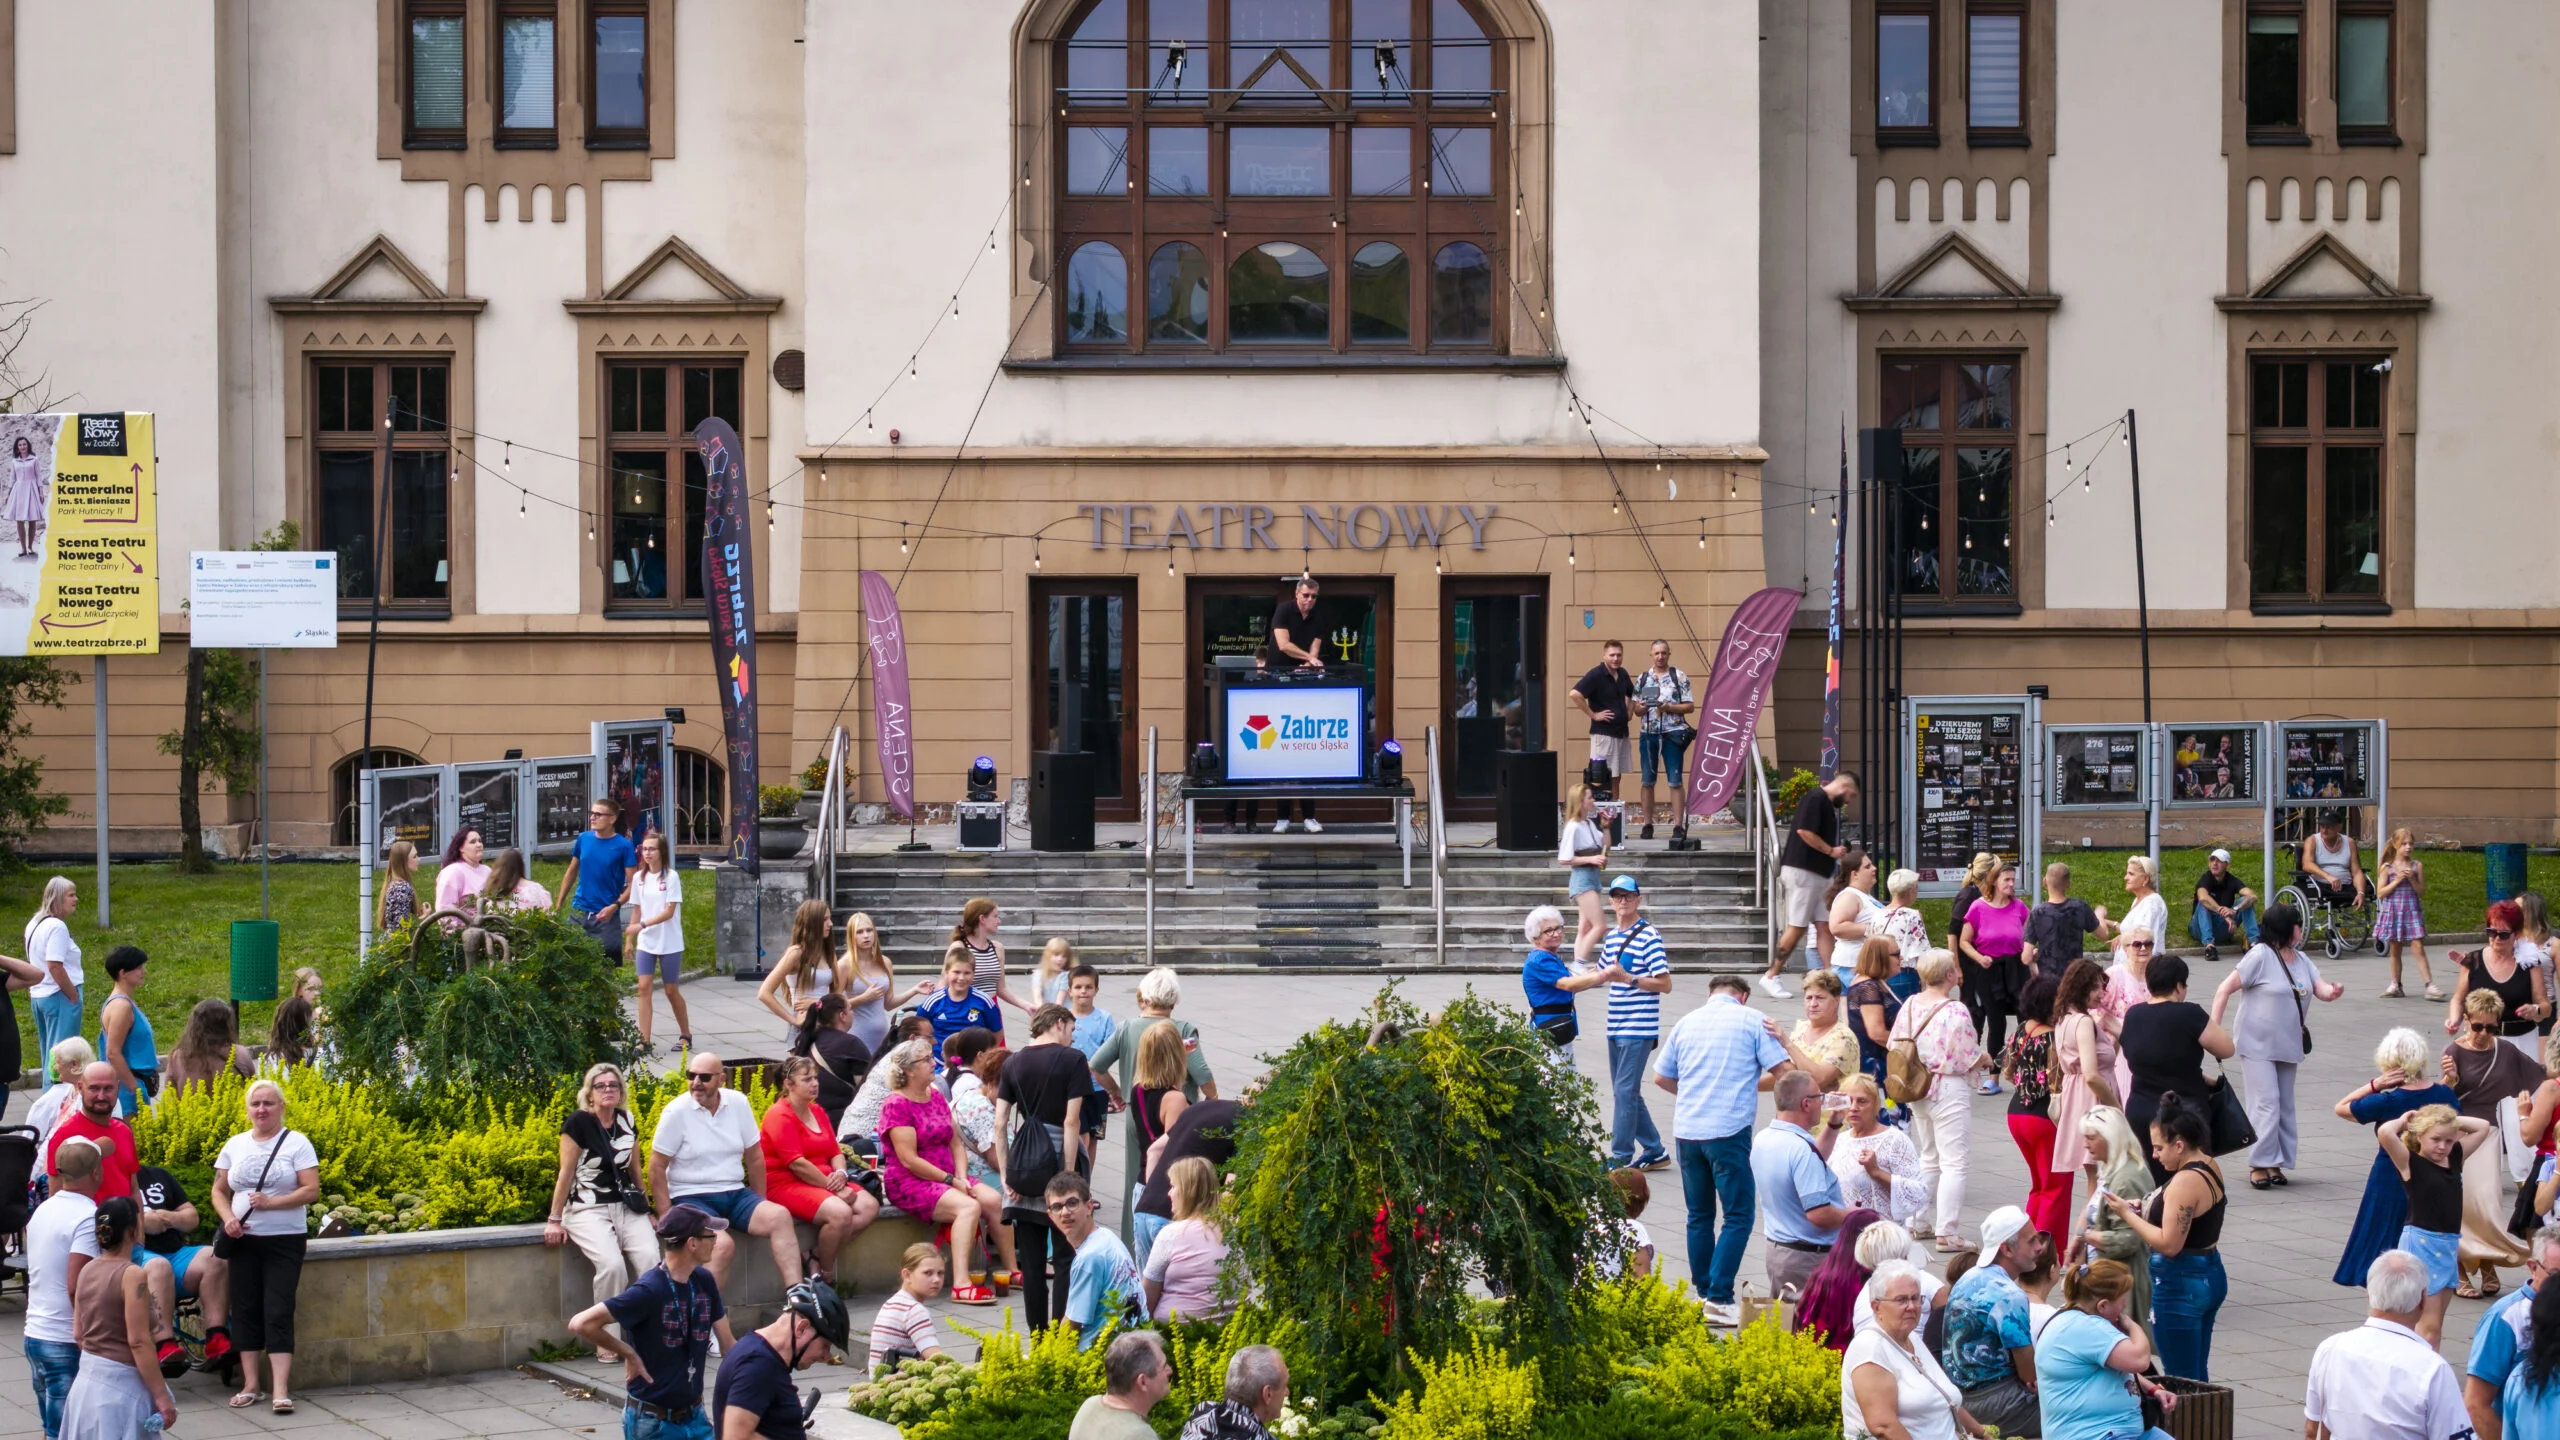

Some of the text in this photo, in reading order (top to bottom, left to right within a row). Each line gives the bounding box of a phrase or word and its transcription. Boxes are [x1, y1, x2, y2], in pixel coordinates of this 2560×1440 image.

[82, 418, 119, 429] Teatr
[84, 427, 119, 442] Nowy
[57, 472, 98, 482] Scena
[57, 484, 134, 495] Kameralna
[57, 496, 131, 505] im. St. Bieniasza
[57, 507, 76, 515] Park
[79, 507, 115, 516] Hutniczy
[1078, 503, 1498, 550] TEATR NOWY
[57, 537, 146, 548] Scena Teatru
[58, 550, 113, 563] Nowego
[58, 563, 77, 571] Plac
[79, 563, 119, 571] Teatralny
[58, 585, 140, 595] Kasa Teatru
[58, 597, 113, 611] Nowego
[84, 610, 139, 619] Mikulczyckiej
[33, 637, 147, 649] www.teatrzabrze.pl
[1218, 634, 1266, 643] Biuro Promocji
[1211, 643, 1247, 652] Organizacji
[1281, 714, 1348, 740] Zabrze
[1736, 686, 1760, 764] cocktail bar
[1935, 720, 1983, 728] DZIĘKUJEMY
[1957, 727, 1982, 735] SEZON
[1281, 739, 1349, 752] w sercu Śląska
[2085, 739, 2104, 748] 276
[1697, 708, 1742, 798] SCENA
[1917, 730, 1926, 777] repertuar
[2111, 745, 2135, 753] 56497
[537, 772, 557, 781] UKCESY
[1928, 809, 1970, 818] ZAPRASZAMY
